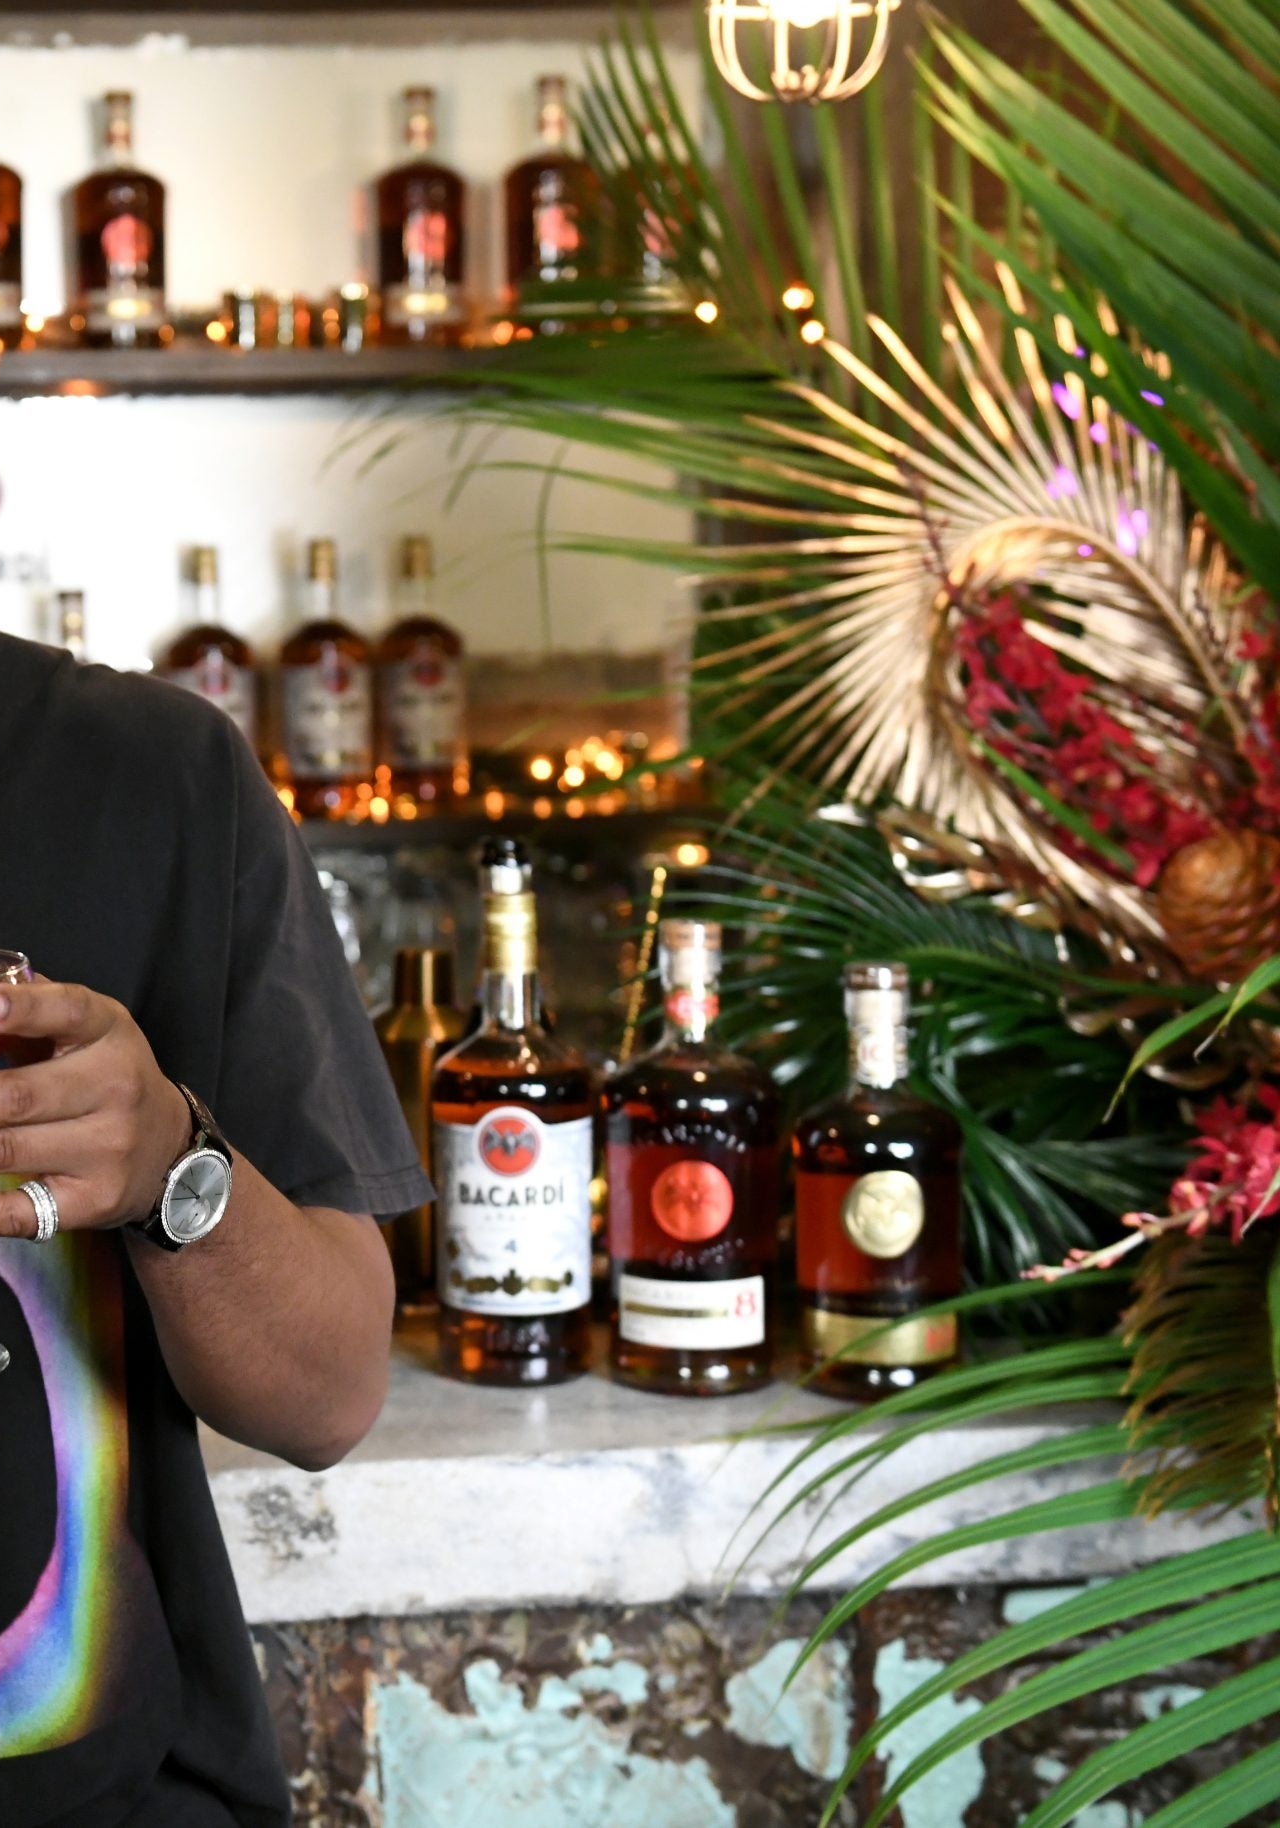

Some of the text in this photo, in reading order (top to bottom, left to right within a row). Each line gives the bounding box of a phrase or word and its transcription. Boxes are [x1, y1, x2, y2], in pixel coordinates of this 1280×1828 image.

[458, 1176, 565, 1207] BACARDÍ
[504, 1238, 518, 1254] 4
[734, 1289, 757, 1318] 8
